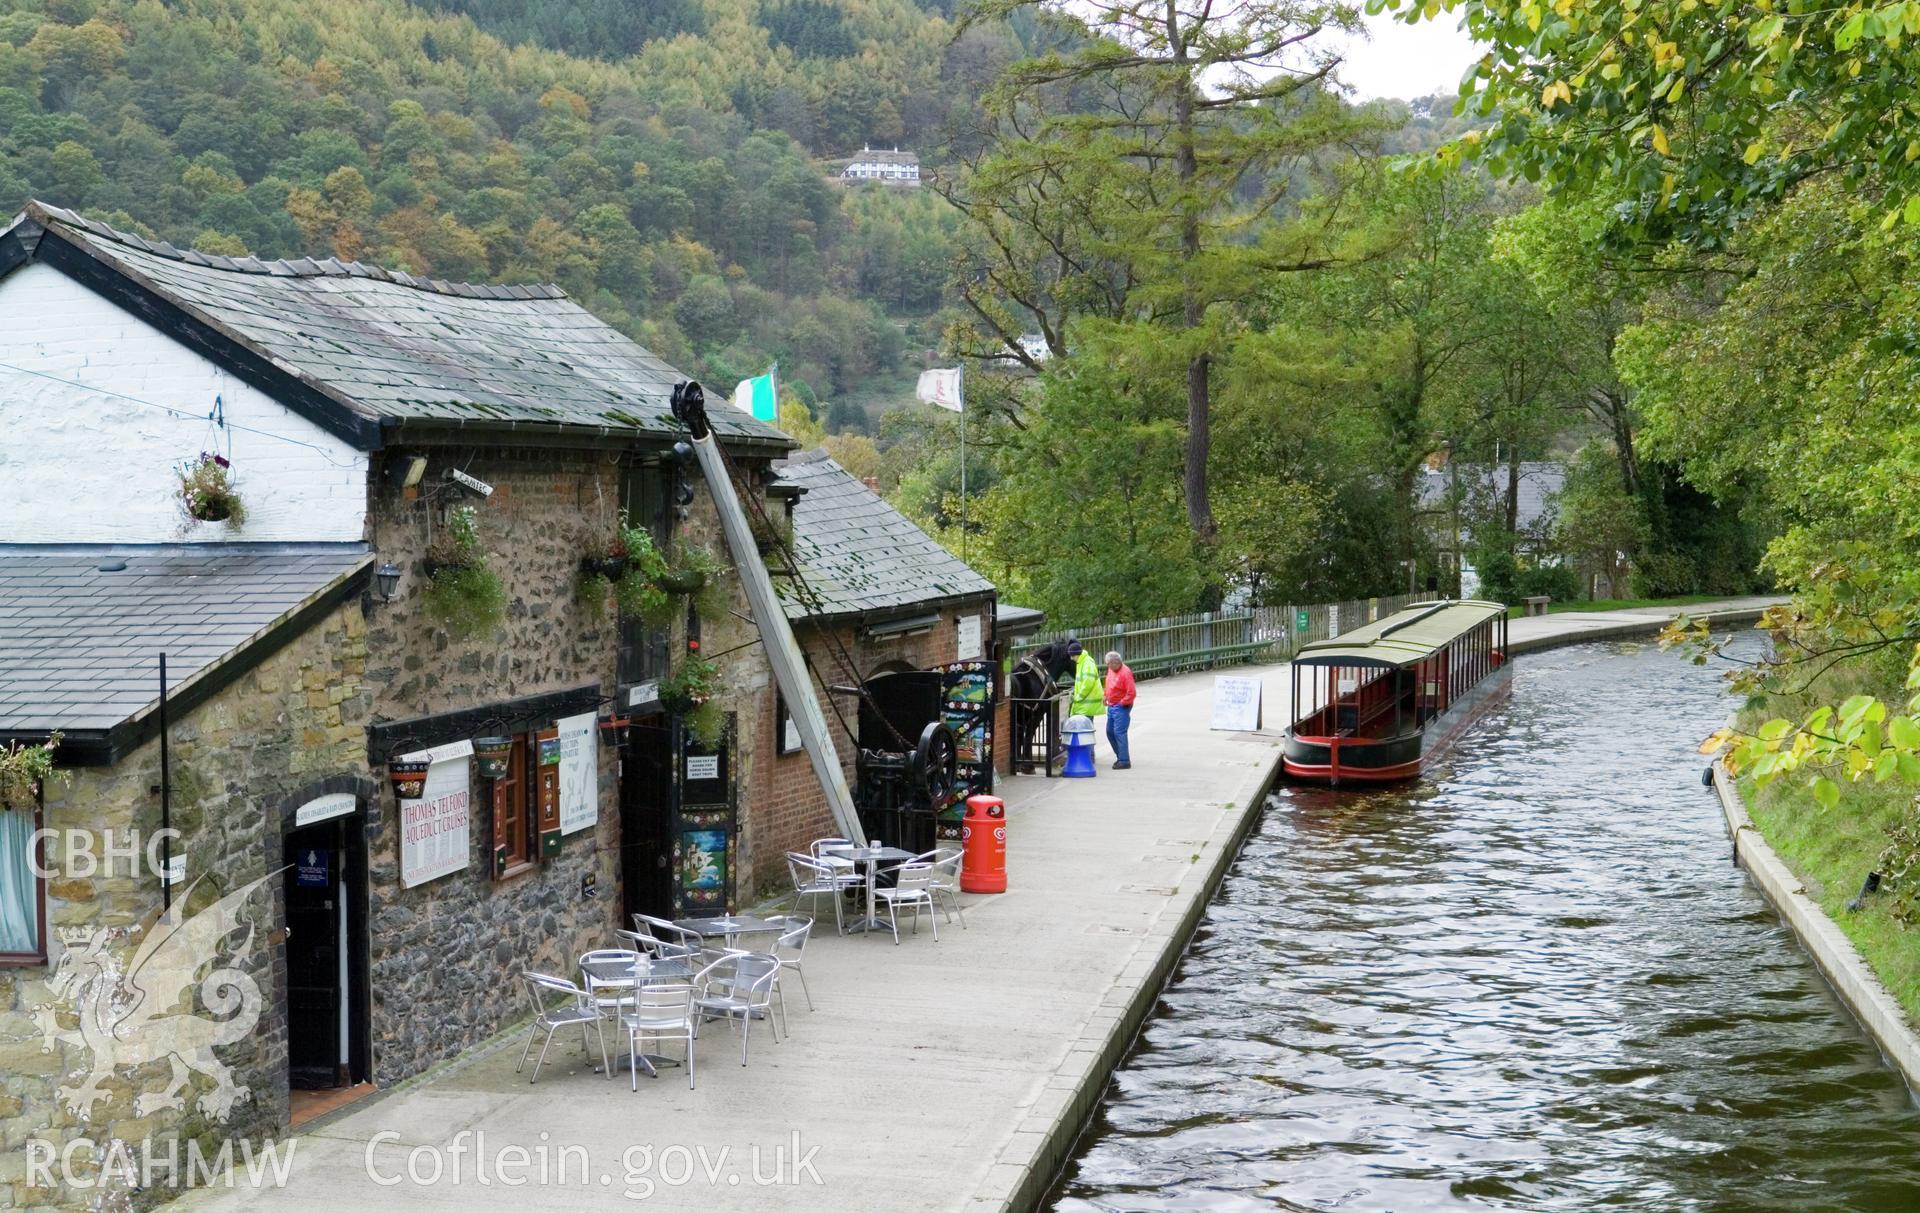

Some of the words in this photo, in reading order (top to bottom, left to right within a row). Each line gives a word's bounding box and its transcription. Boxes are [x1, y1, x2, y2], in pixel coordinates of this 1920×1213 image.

[404, 800, 436, 824] THOMAS
[438, 791, 468, 816] TELFORD
[406, 818, 442, 846] AQUEDUCT
[442, 811, 468, 832] CRUISES
